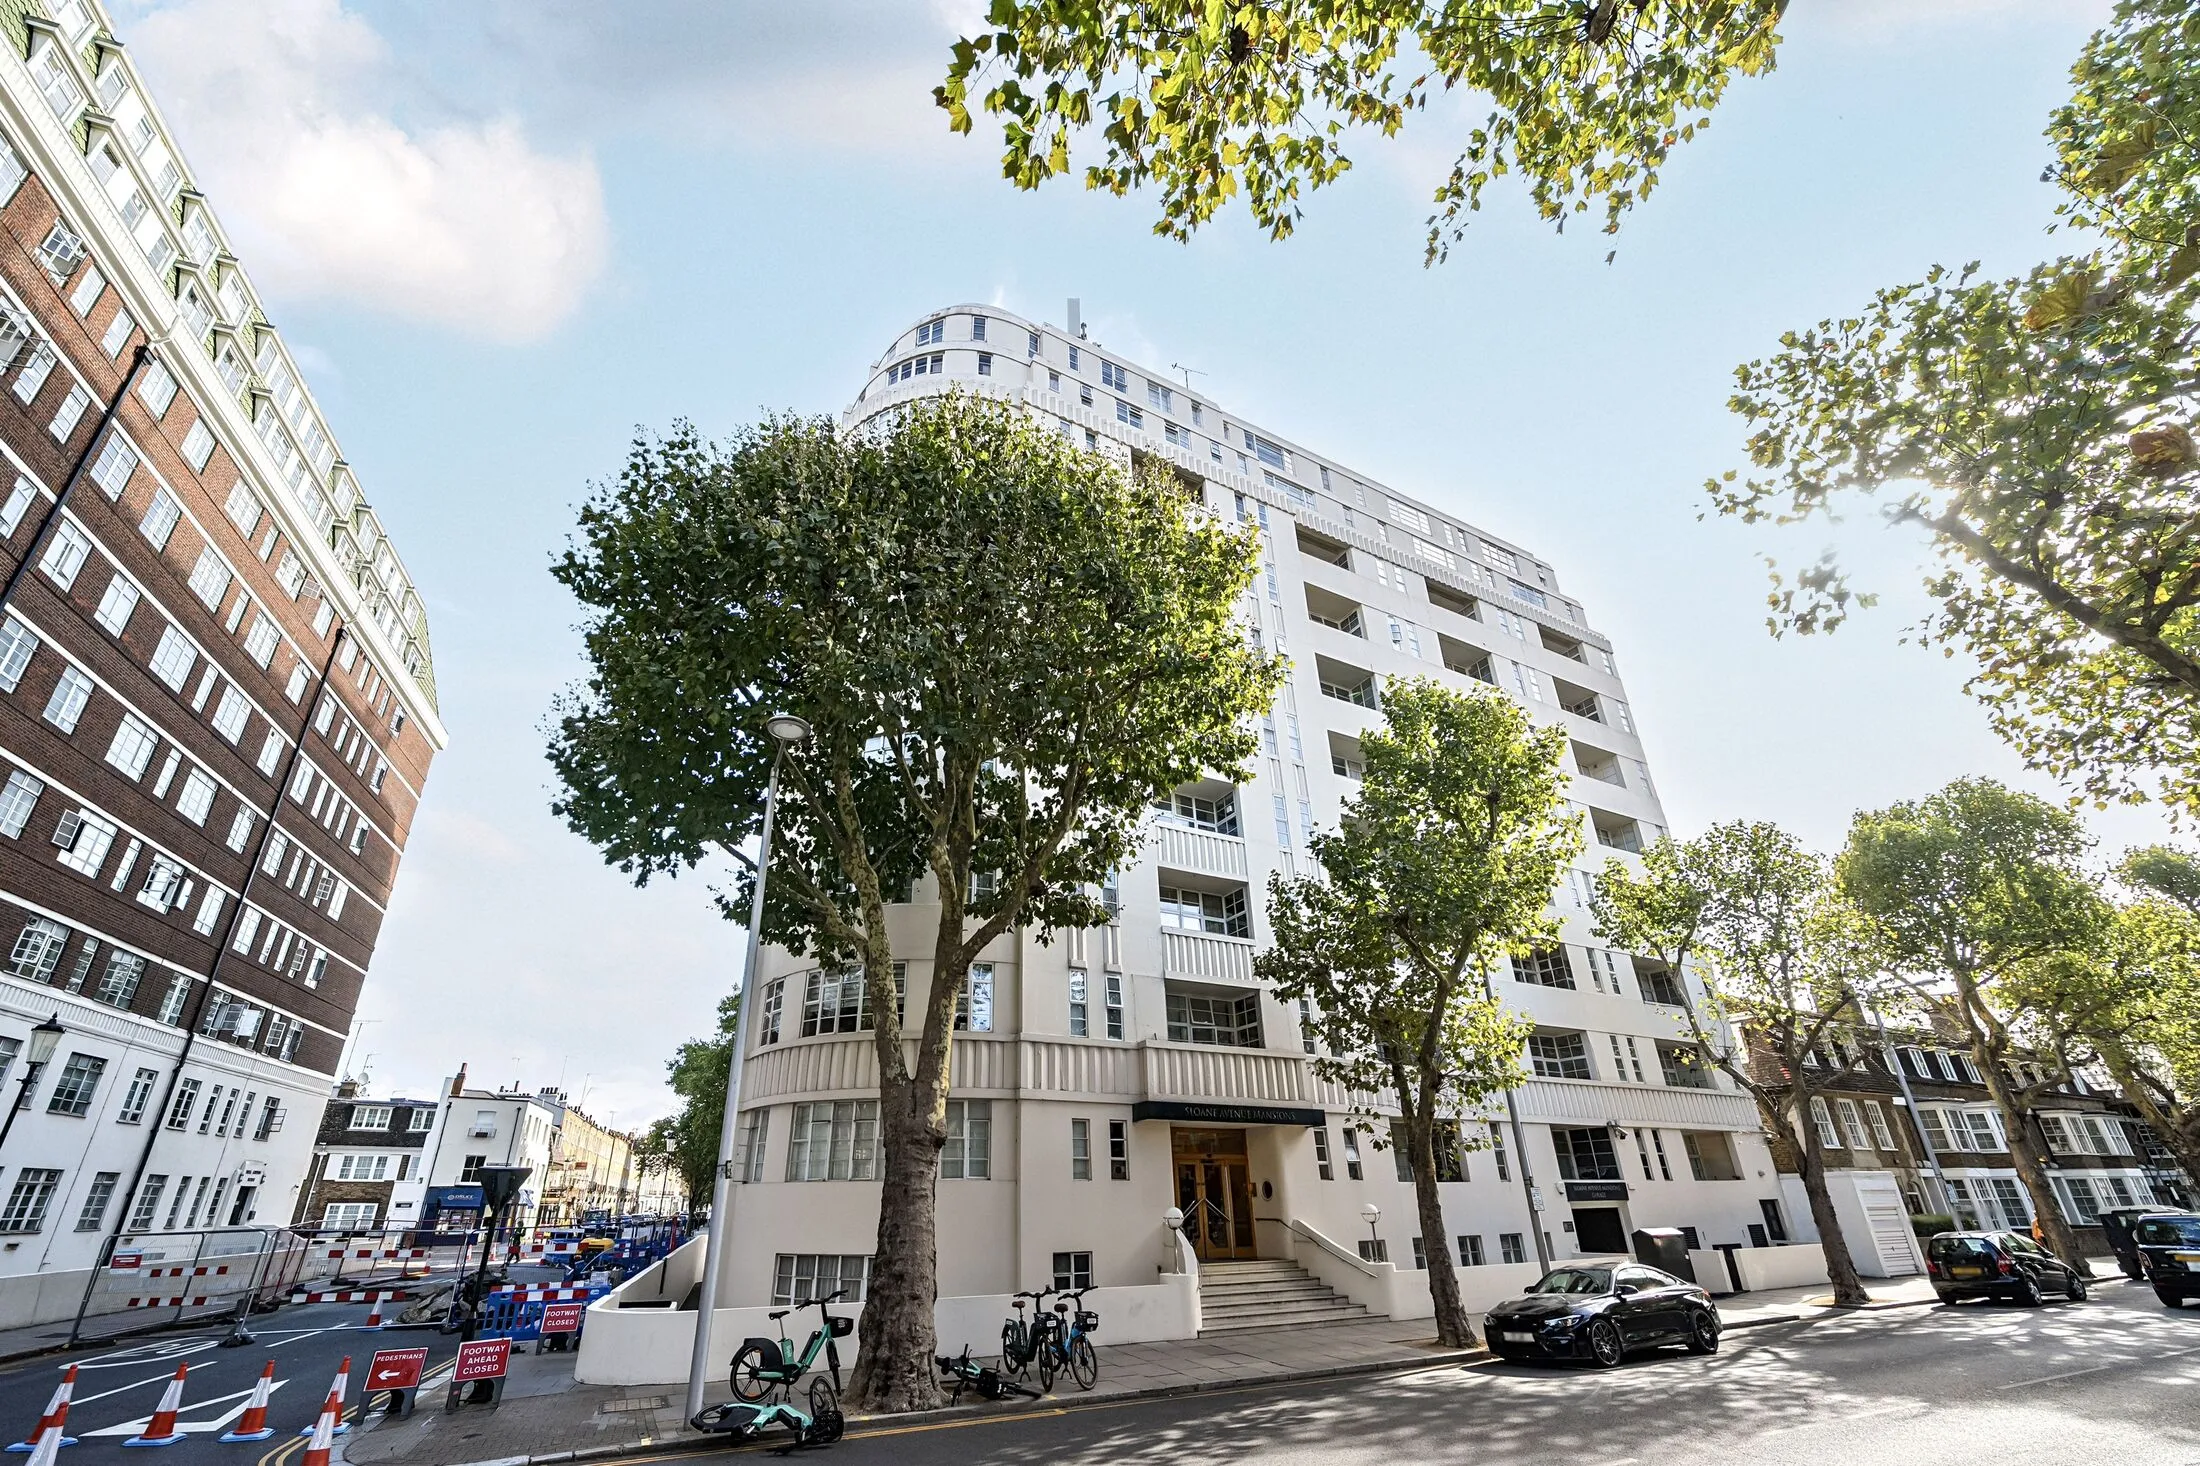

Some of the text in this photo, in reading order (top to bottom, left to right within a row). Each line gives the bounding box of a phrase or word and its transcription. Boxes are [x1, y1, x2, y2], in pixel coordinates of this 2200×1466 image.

[1184, 1106, 1297, 1121] SLOANE AVENUE MANSIONS
[463, 1344, 507, 1356] FOOTWAY
[376, 1352, 424, 1362] PEDESTRIANS
[467, 1356, 498, 1365] AHEAD
[462, 1364, 499, 1375] CLOSED
